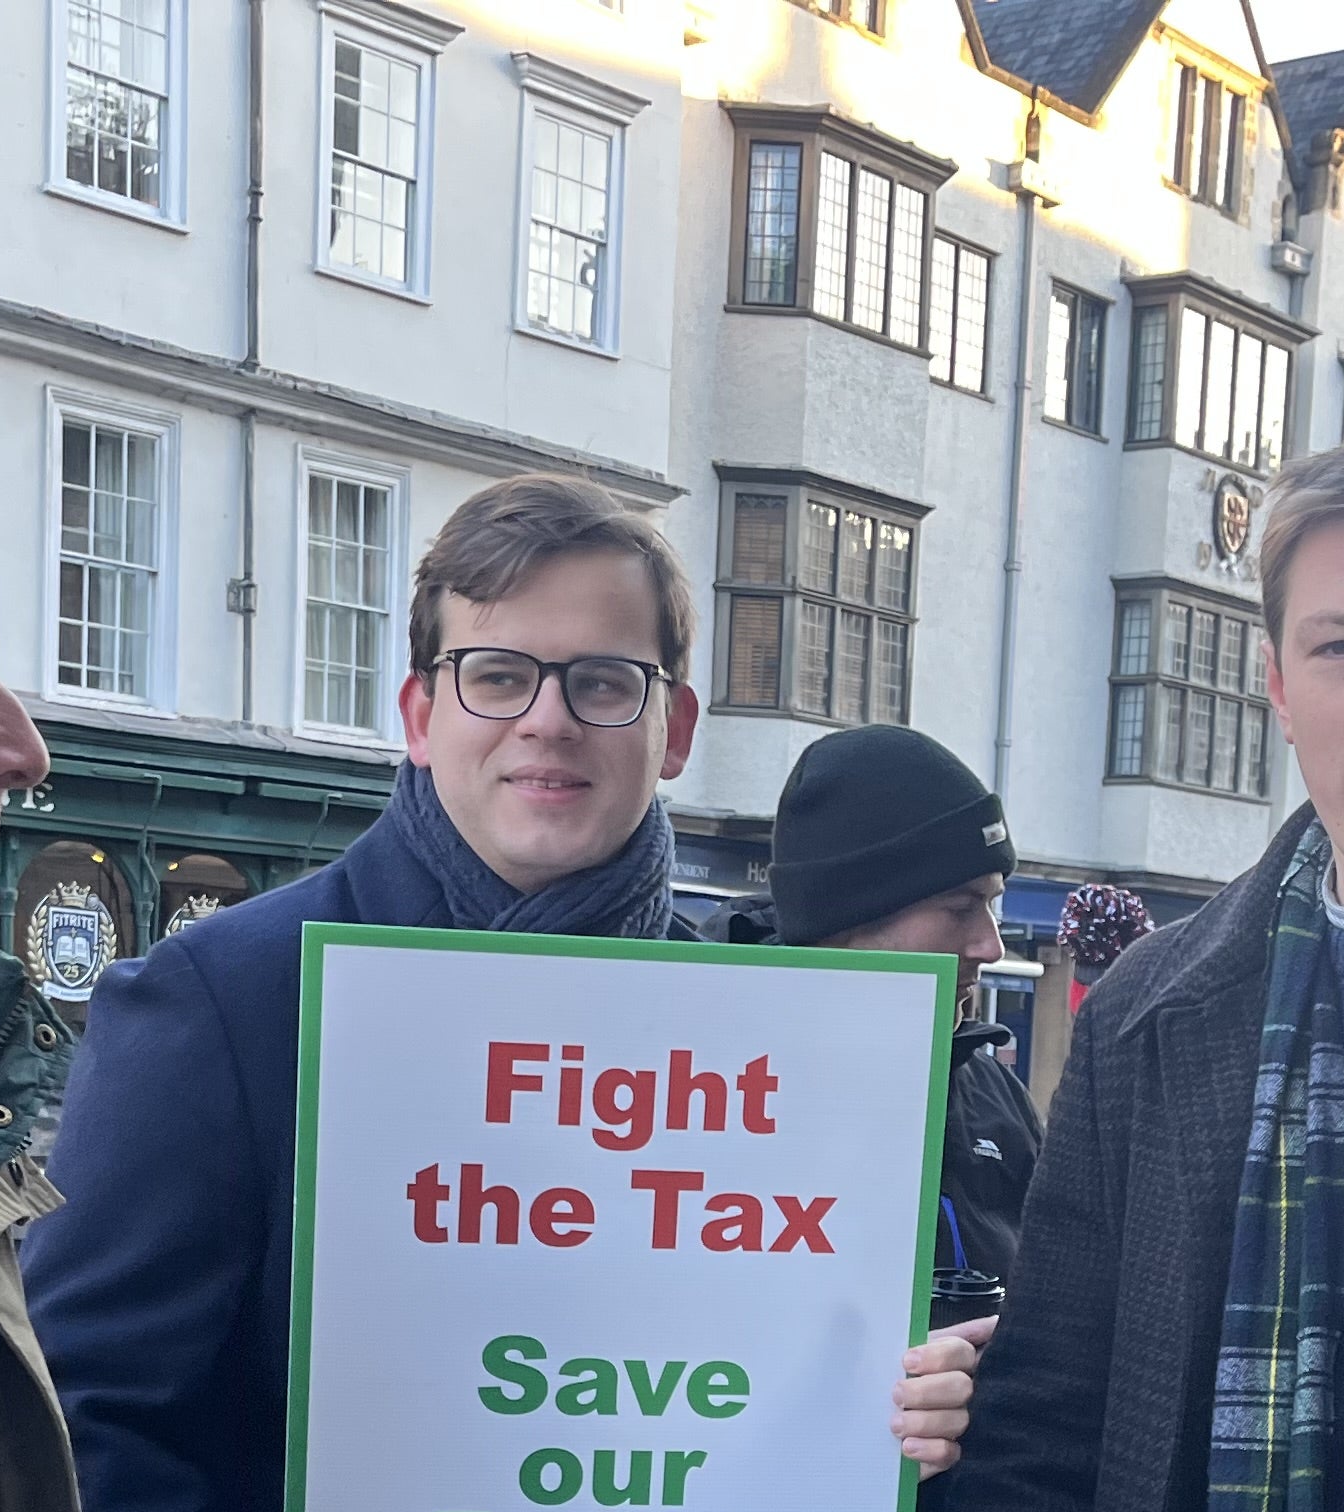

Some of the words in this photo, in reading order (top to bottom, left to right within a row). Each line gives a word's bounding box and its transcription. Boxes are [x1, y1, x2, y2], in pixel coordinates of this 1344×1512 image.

[53, 912, 95, 933] FITRITE
[63, 964, 80, 979] 25
[487, 1043, 778, 1150] Fight
[409, 1166, 594, 1246] the
[632, 1171, 834, 1252] Tax
[479, 1334, 751, 1420] Save
[519, 1447, 709, 1508] our
